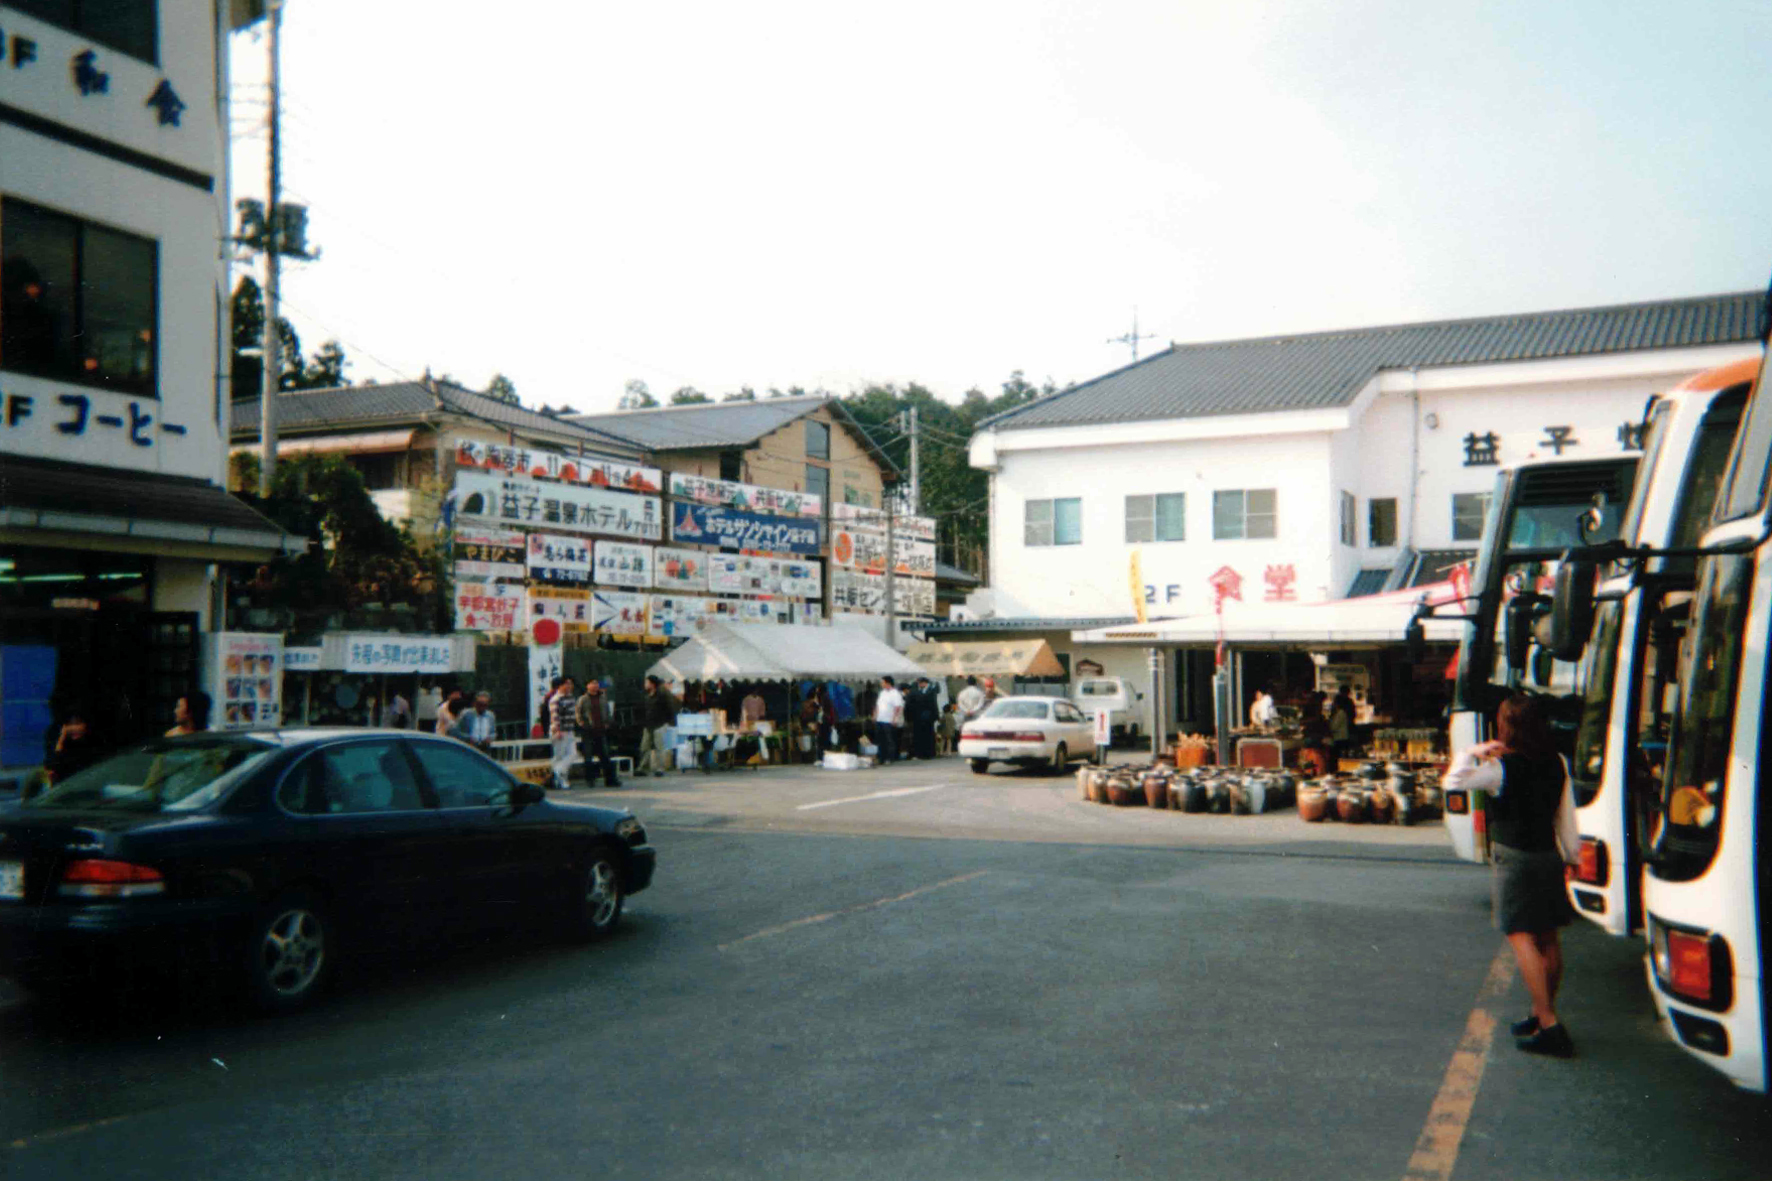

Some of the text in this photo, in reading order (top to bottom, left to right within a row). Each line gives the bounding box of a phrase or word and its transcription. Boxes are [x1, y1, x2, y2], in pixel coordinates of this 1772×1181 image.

[0, 28, 37, 69] F
[0, 394, 186, 446] F コーヒー
[501, 493, 632, 530] 益子温泉ホテル
[1144, 583, 1180, 604] 2F
[1208, 564, 1297, 603] 食堂
